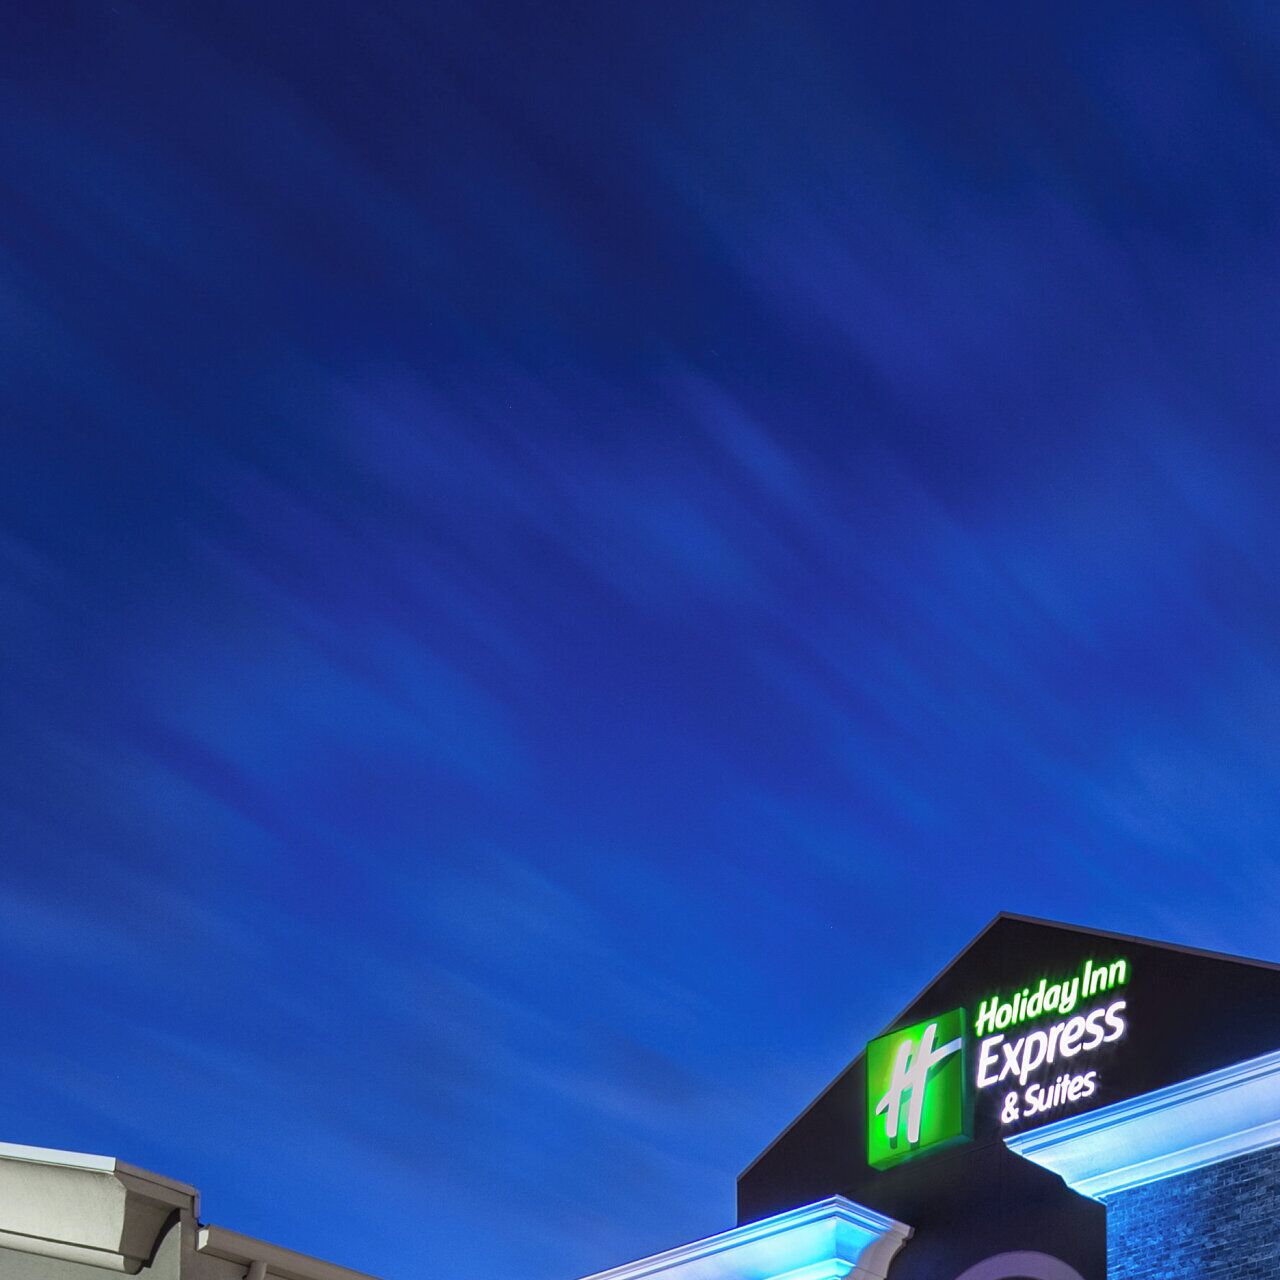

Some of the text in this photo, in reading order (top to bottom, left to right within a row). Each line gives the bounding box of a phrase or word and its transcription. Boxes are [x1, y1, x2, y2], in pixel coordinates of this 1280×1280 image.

[975, 960, 1126, 1037] Holiday Inn
[875, 1022, 962, 1143] H
[977, 1001, 1127, 1088] Express
[1001, 1071, 1097, 1124] & Suites
